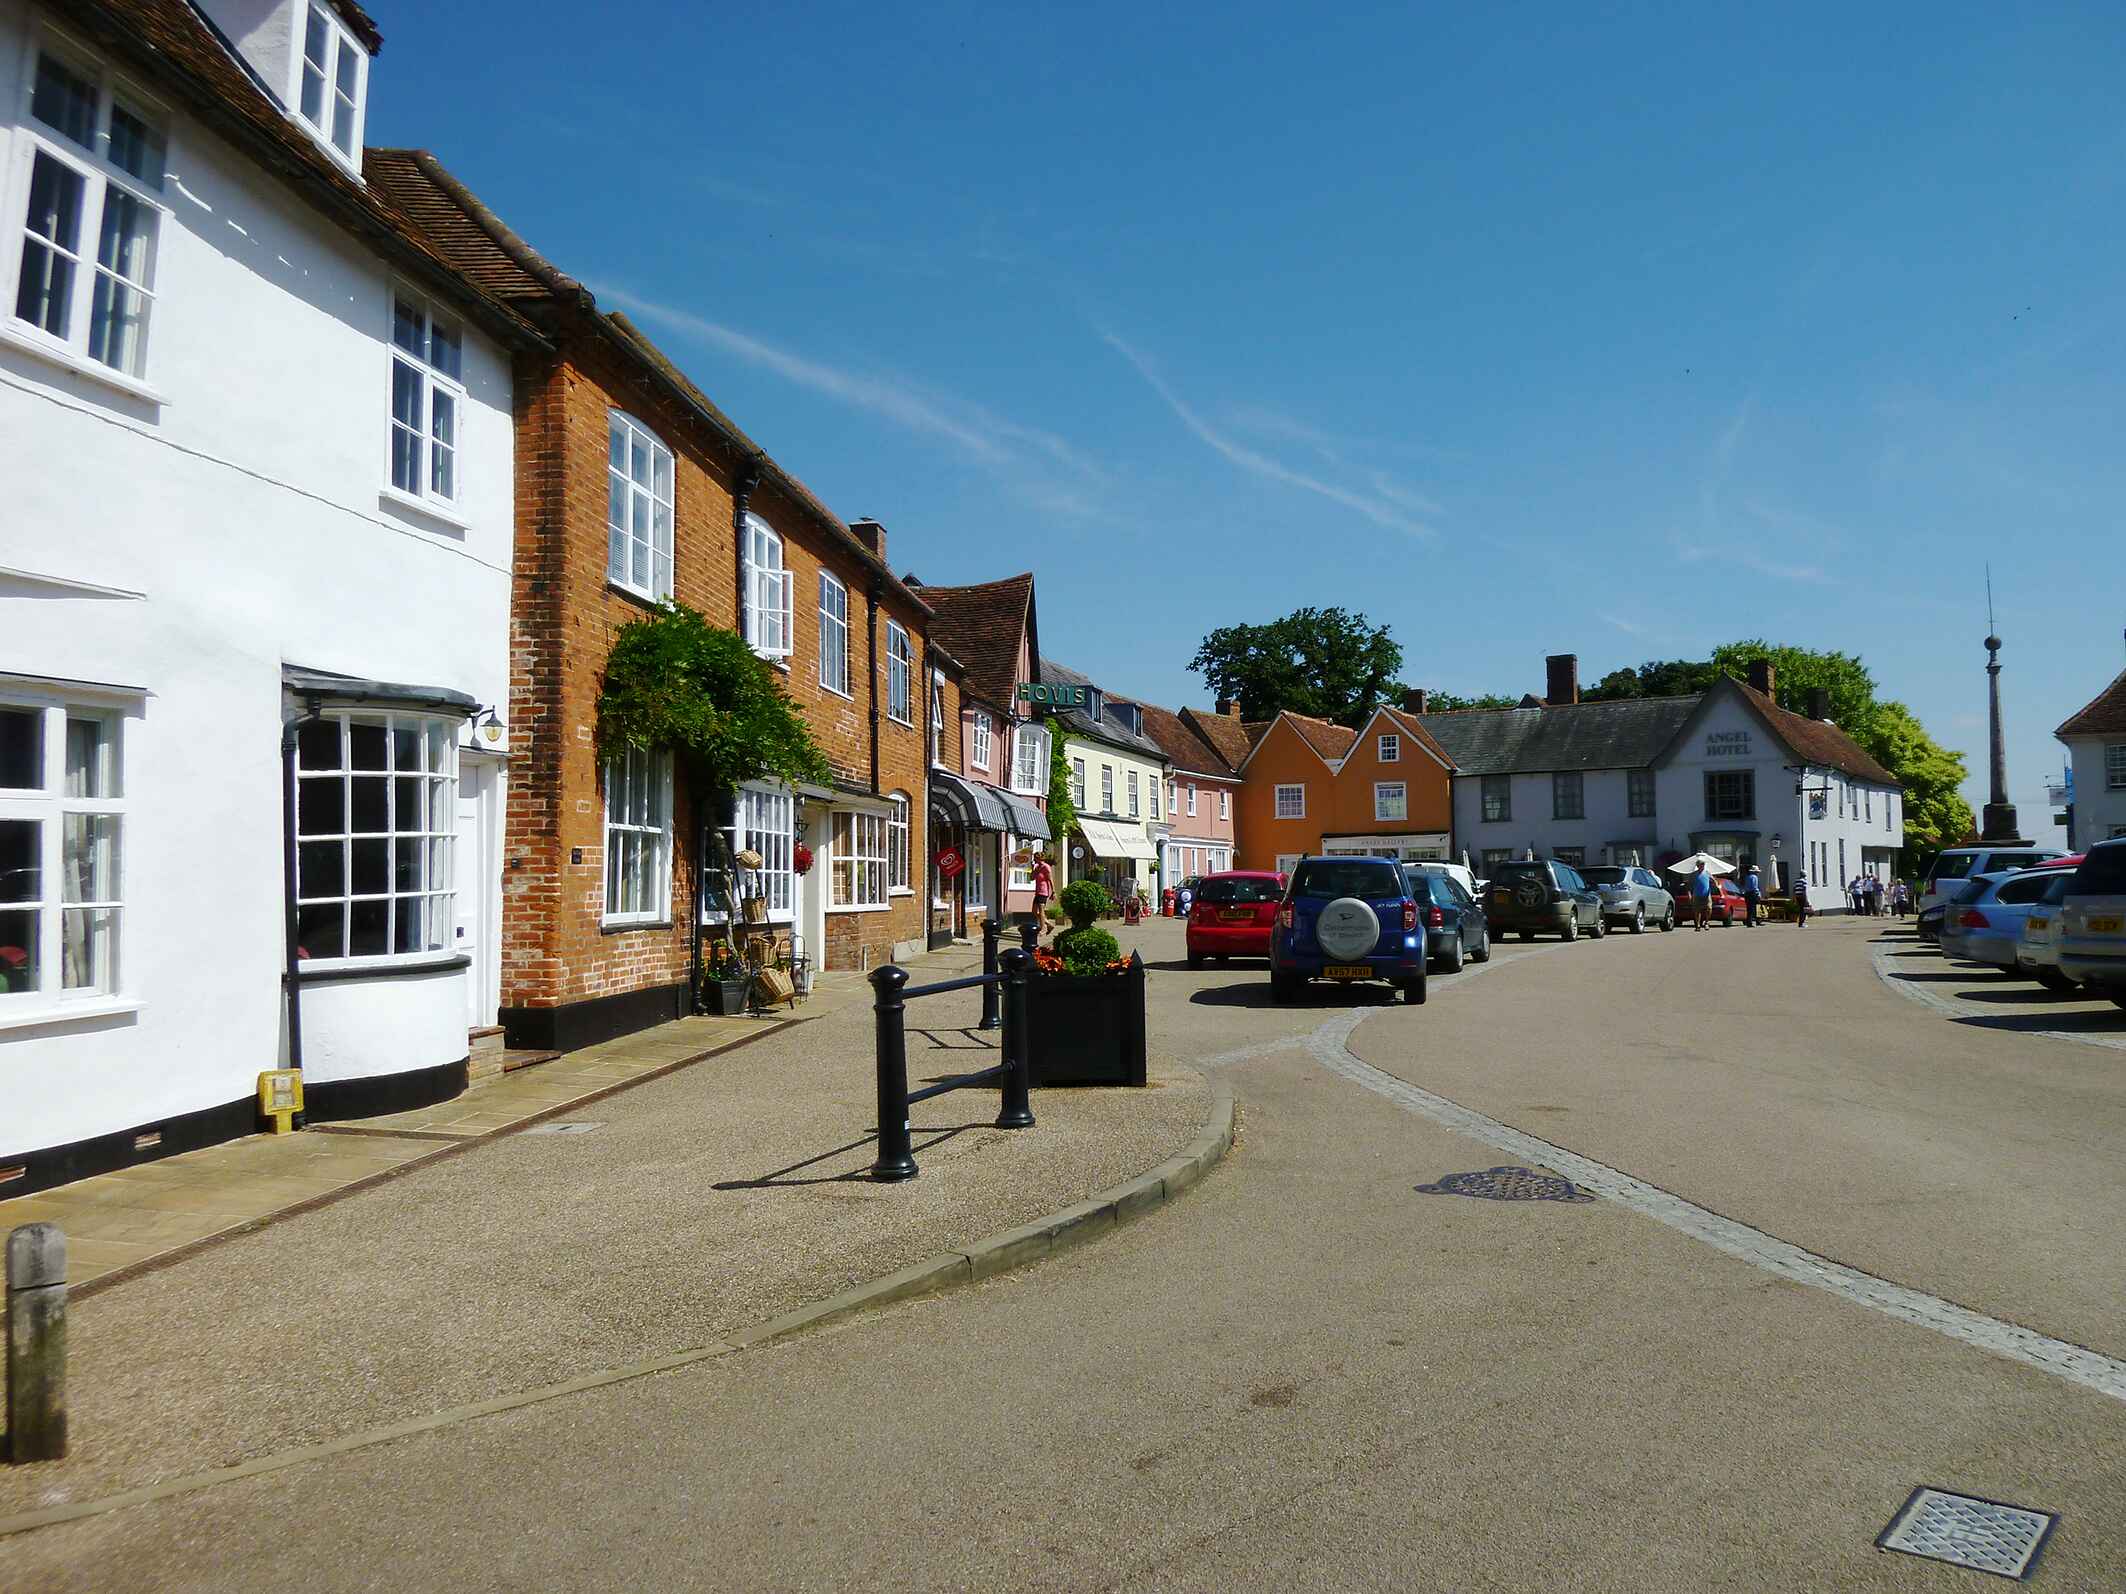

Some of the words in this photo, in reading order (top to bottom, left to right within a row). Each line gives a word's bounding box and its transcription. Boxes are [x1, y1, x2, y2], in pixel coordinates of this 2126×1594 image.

[1020, 684, 1085, 703] HOVIS
[1706, 732, 1752, 744] ANGEL
[1706, 744, 1752, 756] HOTEL
